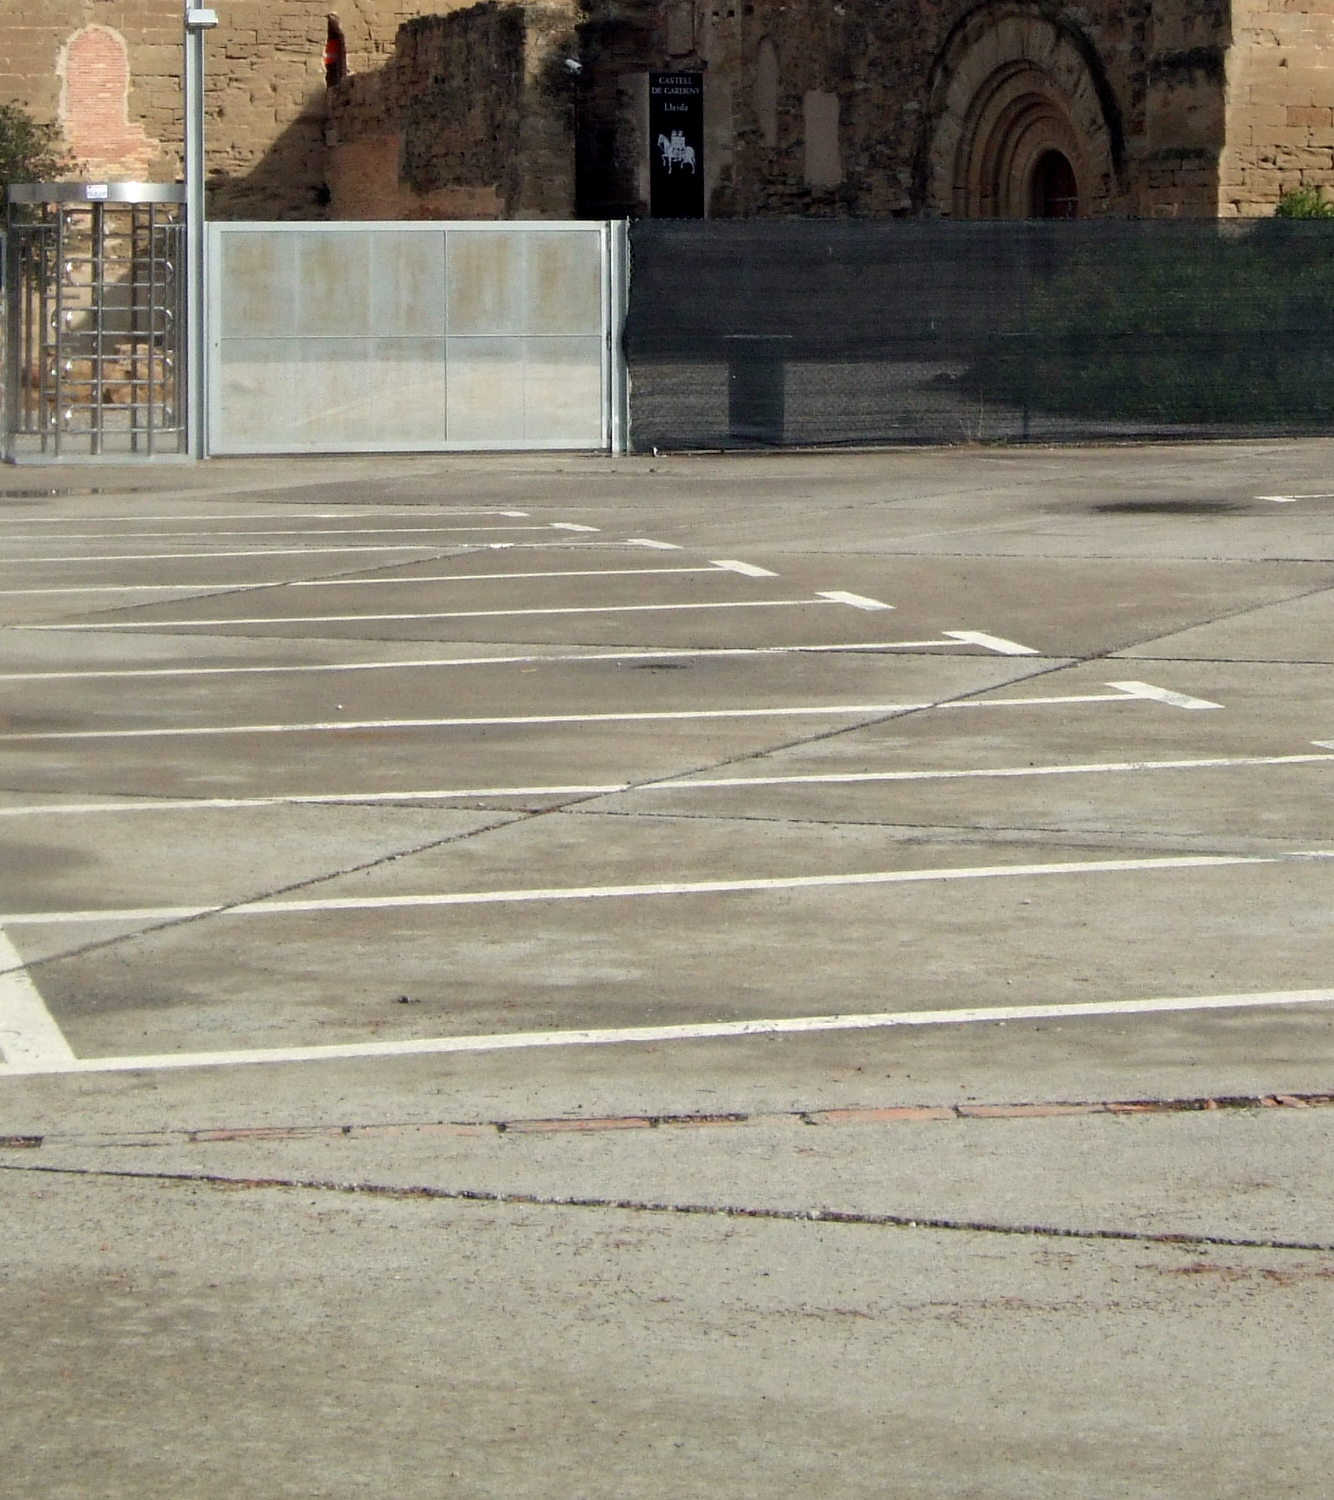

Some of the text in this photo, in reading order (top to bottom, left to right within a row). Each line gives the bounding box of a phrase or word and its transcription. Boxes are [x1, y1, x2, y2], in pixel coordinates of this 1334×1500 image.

[659, 77, 693, 85] CASTELL
[664, 87, 699, 95] GARDENY
[664, 103, 688, 111] Lleida
